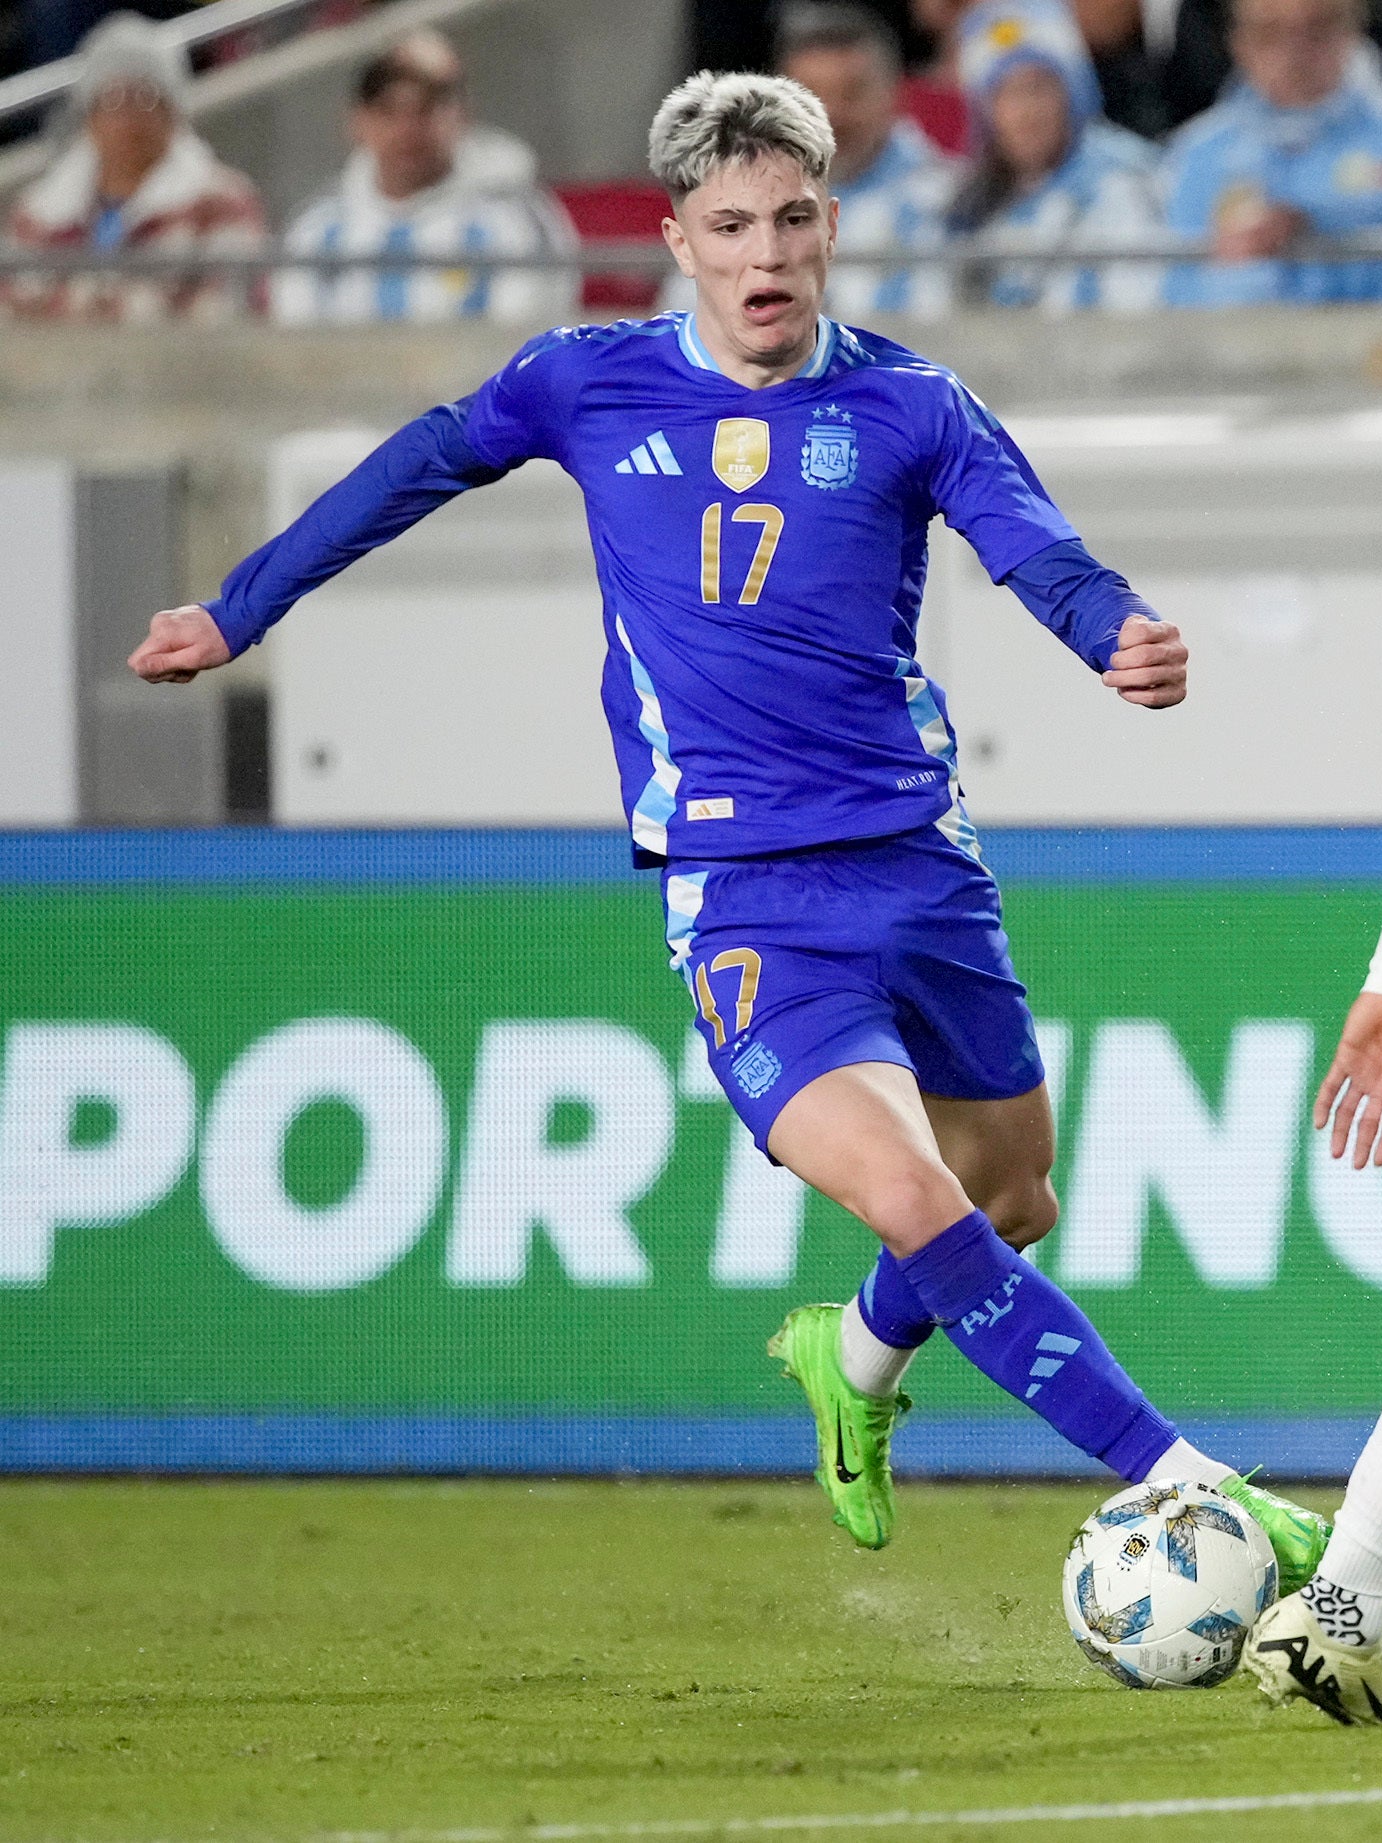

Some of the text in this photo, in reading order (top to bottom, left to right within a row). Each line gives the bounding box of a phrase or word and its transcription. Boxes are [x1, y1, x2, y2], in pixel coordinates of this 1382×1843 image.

[728, 463, 754, 474] FIFA
[813, 440, 847, 472] AFA
[700, 502, 785, 605] 17
[695, 947, 762, 1050] 17
